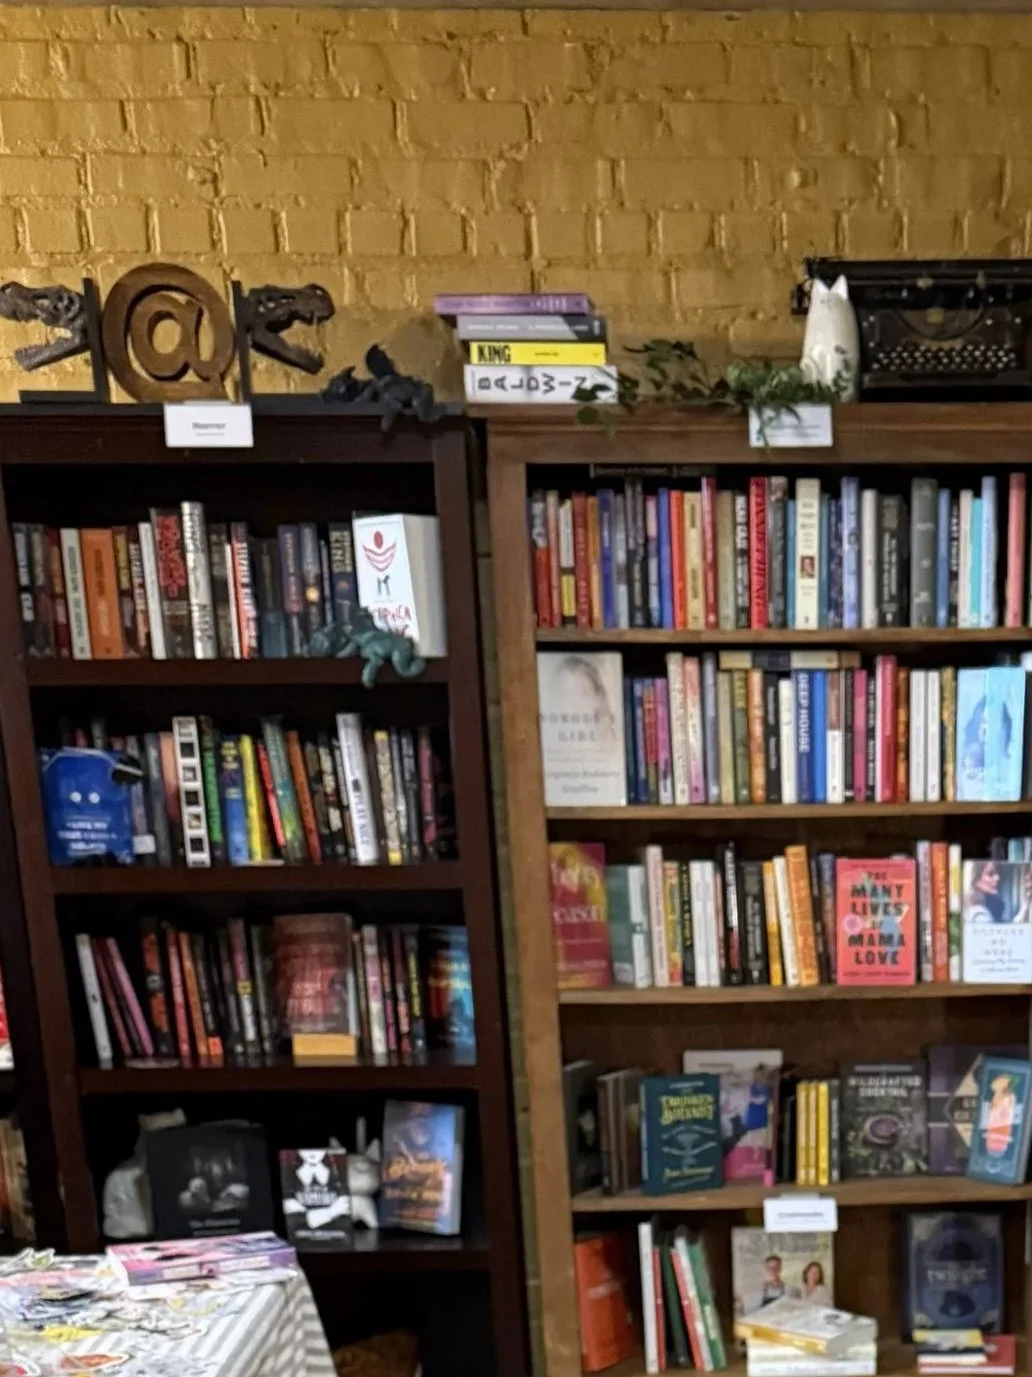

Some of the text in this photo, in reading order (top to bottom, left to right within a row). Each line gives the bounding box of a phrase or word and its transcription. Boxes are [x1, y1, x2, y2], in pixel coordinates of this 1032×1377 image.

[478, 344, 512, 363] KING
[477, 372, 588, 395] BALDWIN
[798, 672, 811, 752] DEEP HOUSE
[850, 884, 905, 898] MANY
[851, 902, 905, 916] LIVES
[848, 933, 906, 948] MAMA
[854, 950, 899, 966] LOVE
